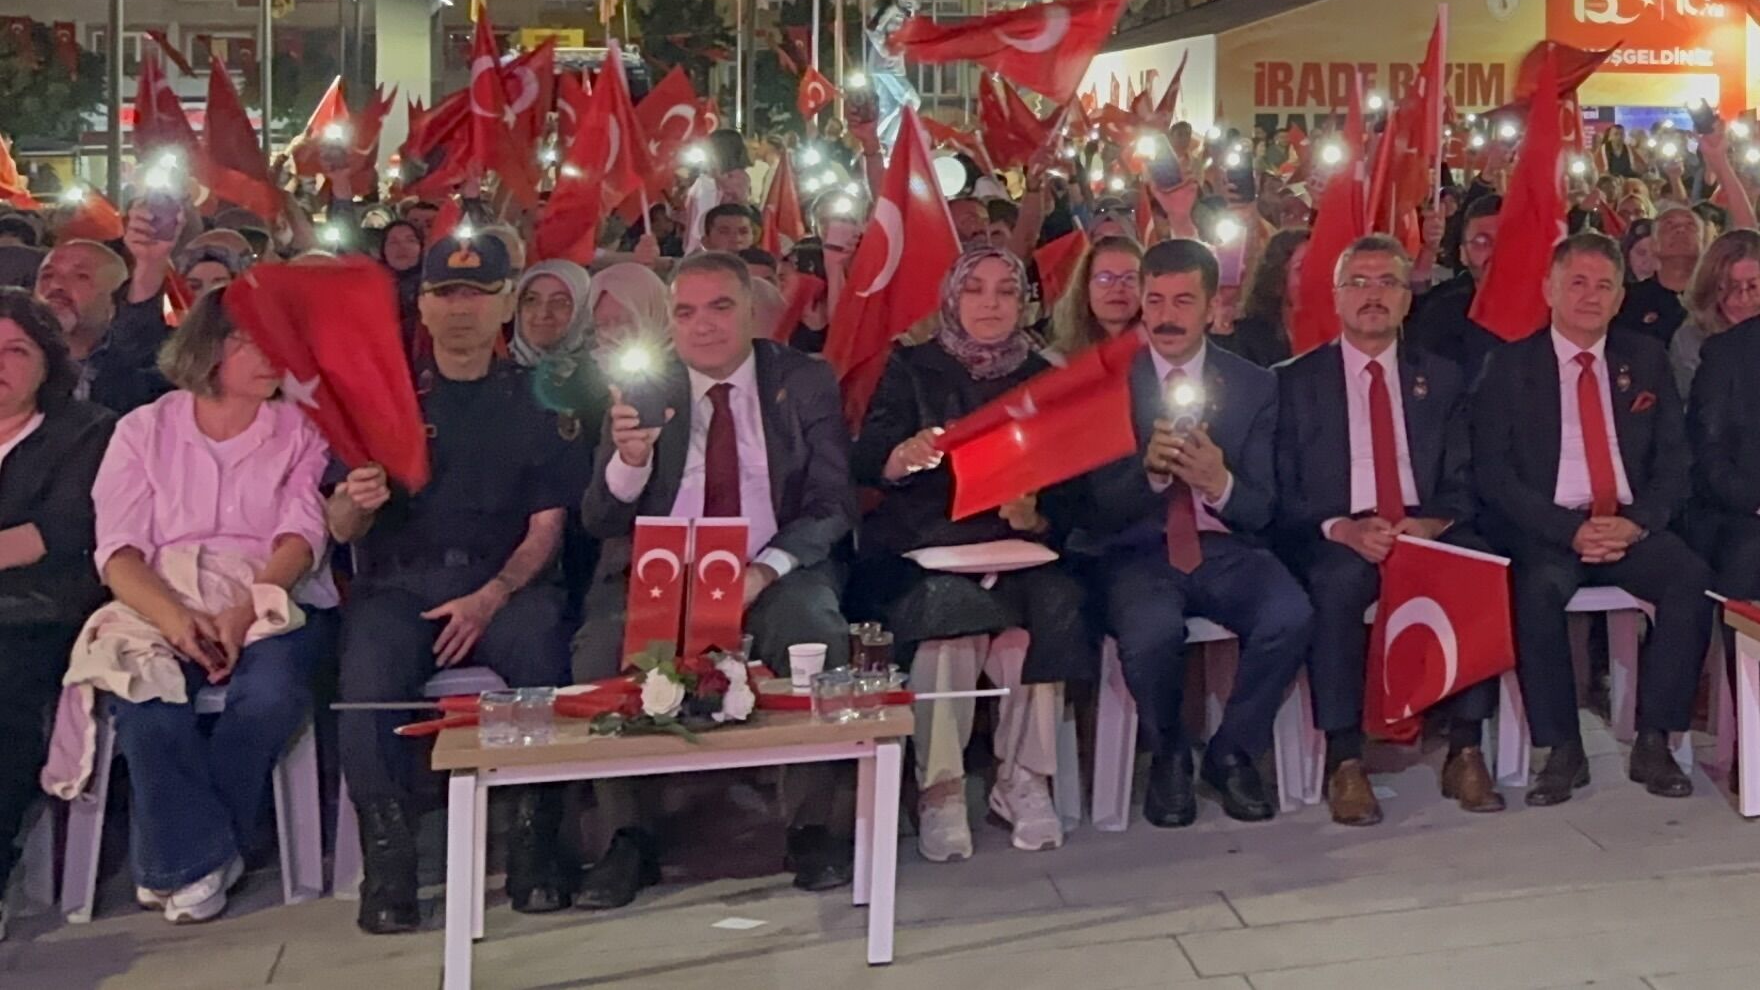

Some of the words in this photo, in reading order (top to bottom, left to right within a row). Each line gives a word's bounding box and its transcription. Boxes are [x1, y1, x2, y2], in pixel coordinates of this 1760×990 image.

[1584, 46, 1713, 67] ŞGELDİNİZ
[1254, 62, 1377, 107] İRADE
[1389, 62, 1505, 107] BİM
